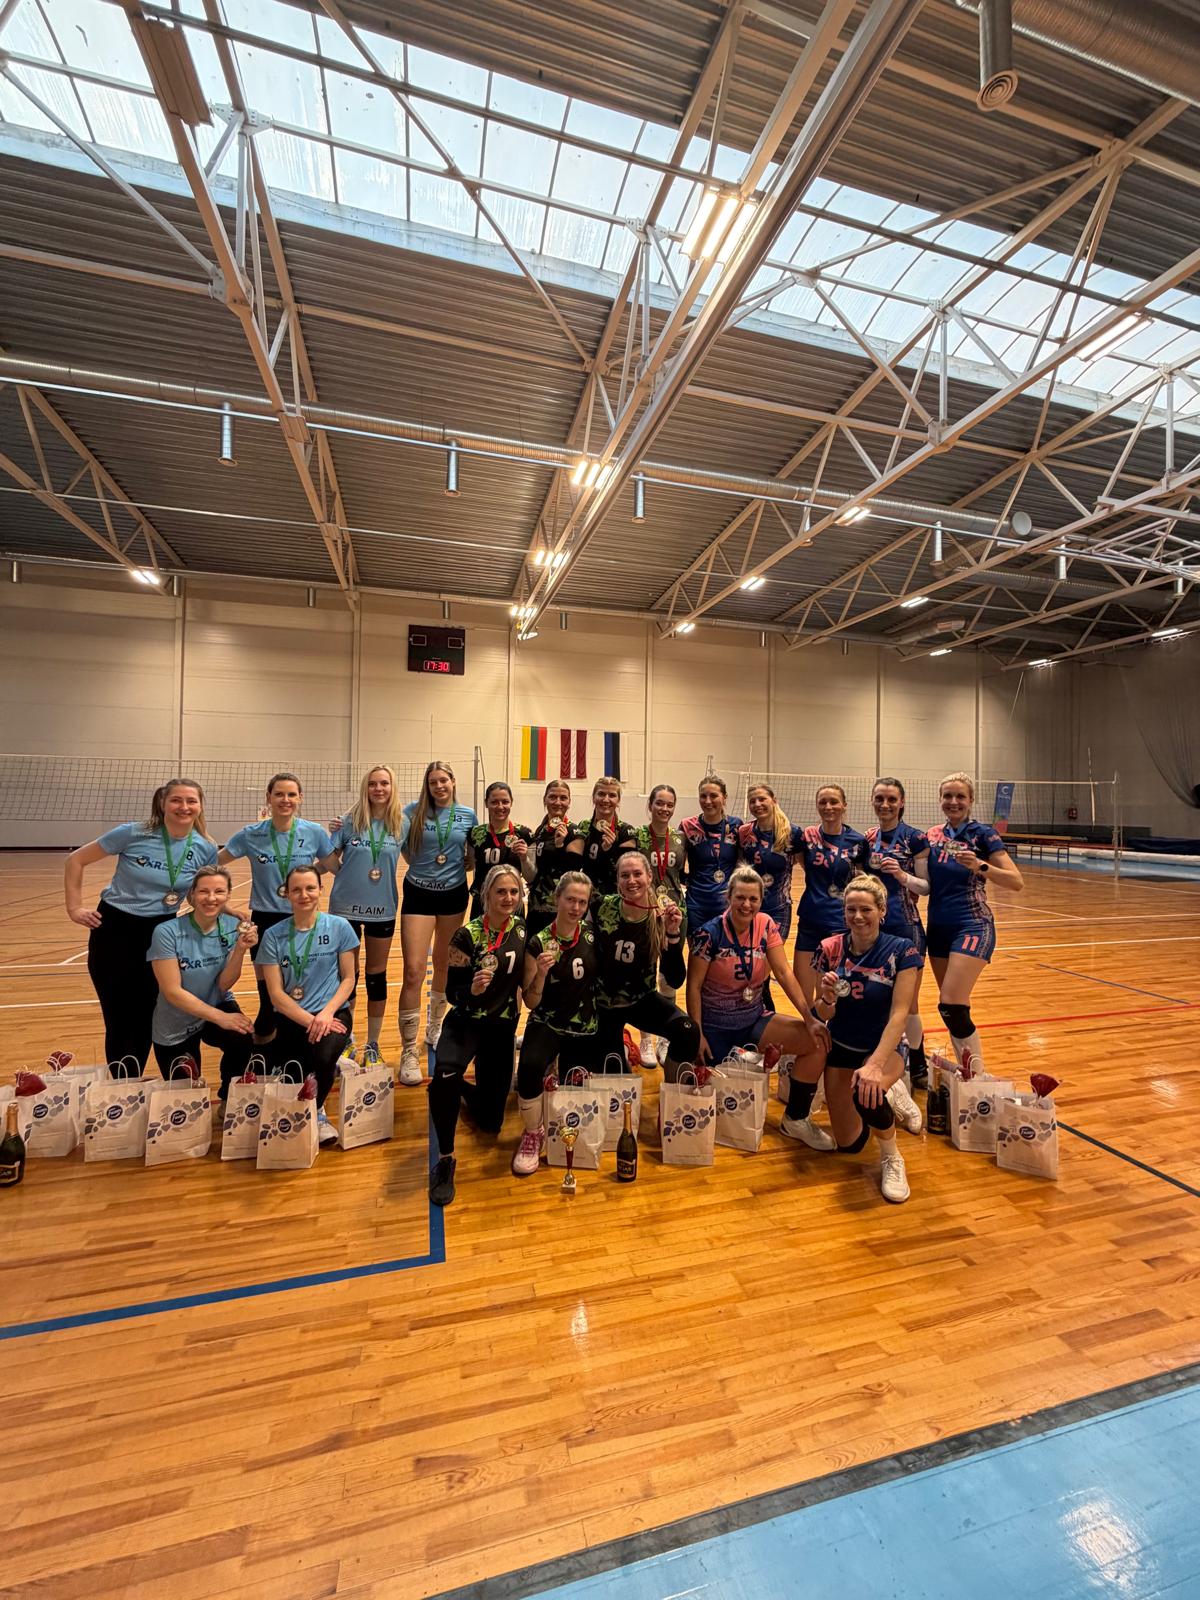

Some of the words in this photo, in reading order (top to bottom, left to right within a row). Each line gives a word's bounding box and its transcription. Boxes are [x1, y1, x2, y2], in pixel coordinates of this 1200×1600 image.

[427, 661, 449, 671] 17:30
[298, 839, 304, 847] 7
[186, 851, 193, 860] 8
[484, 848, 500, 864] 10
[589, 843, 598, 860] 9
[352, 905, 385, 915] FLAIM
[318, 935, 330, 945] 18
[961, 934, 979, 951] 11
[614, 939, 635, 963] 13
[505, 950, 516, 974] 7
[572, 957, 584, 979] 6
